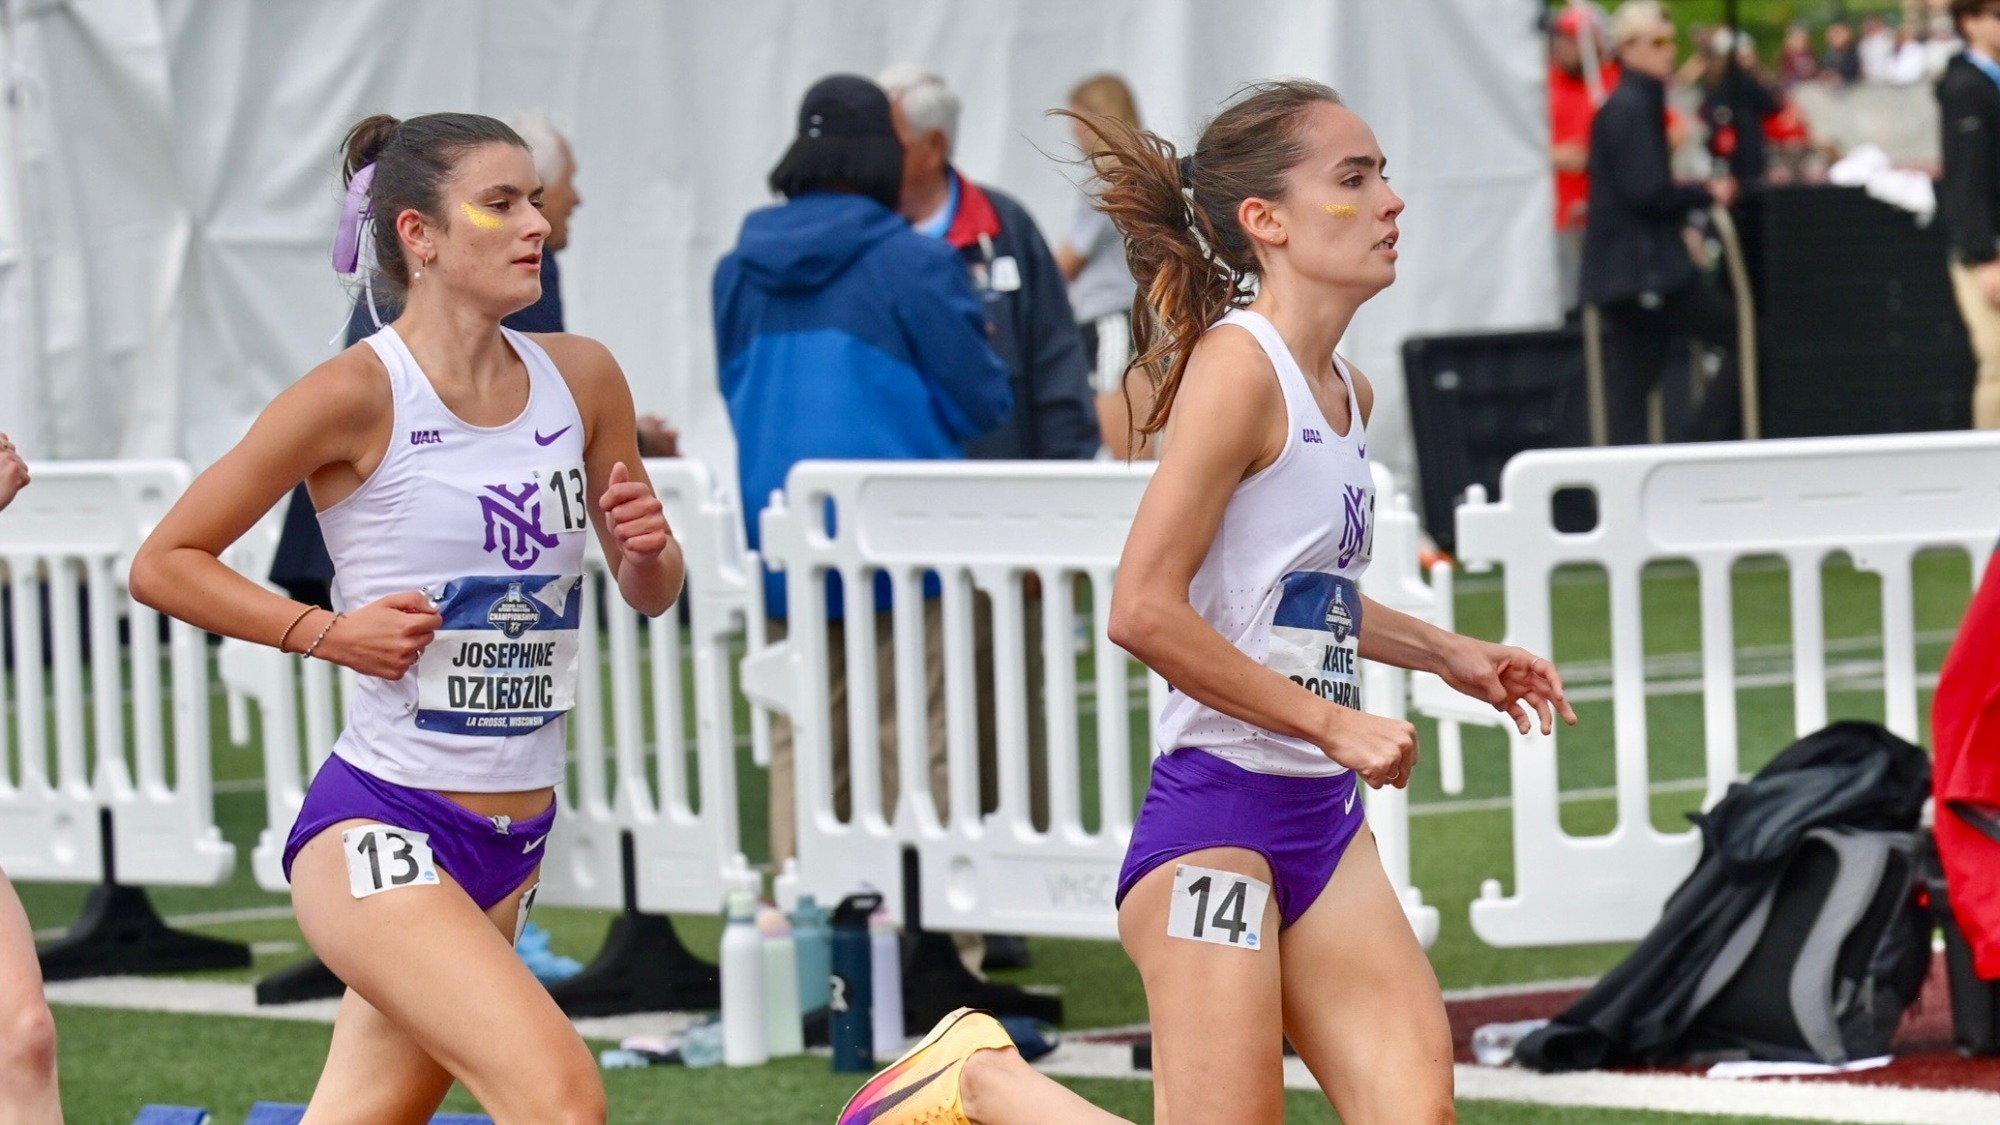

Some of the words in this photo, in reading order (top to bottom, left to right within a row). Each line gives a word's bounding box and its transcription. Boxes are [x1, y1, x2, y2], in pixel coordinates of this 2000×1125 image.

[410, 430, 443, 445] UAA
[1303, 428, 1323, 444] UAA
[549, 468, 587, 530] 13
[452, 641, 556, 669] JOSEPHINE
[1322, 644, 1354, 675] KATE
[447, 674, 553, 710] DZIEDZIC
[465, 716, 477, 727] LA
[477, 716, 508, 728] CROSSE,
[509, 715, 544, 727] WISCONSIN
[357, 831, 420, 890] 13
[1188, 875, 1248, 944] 14
